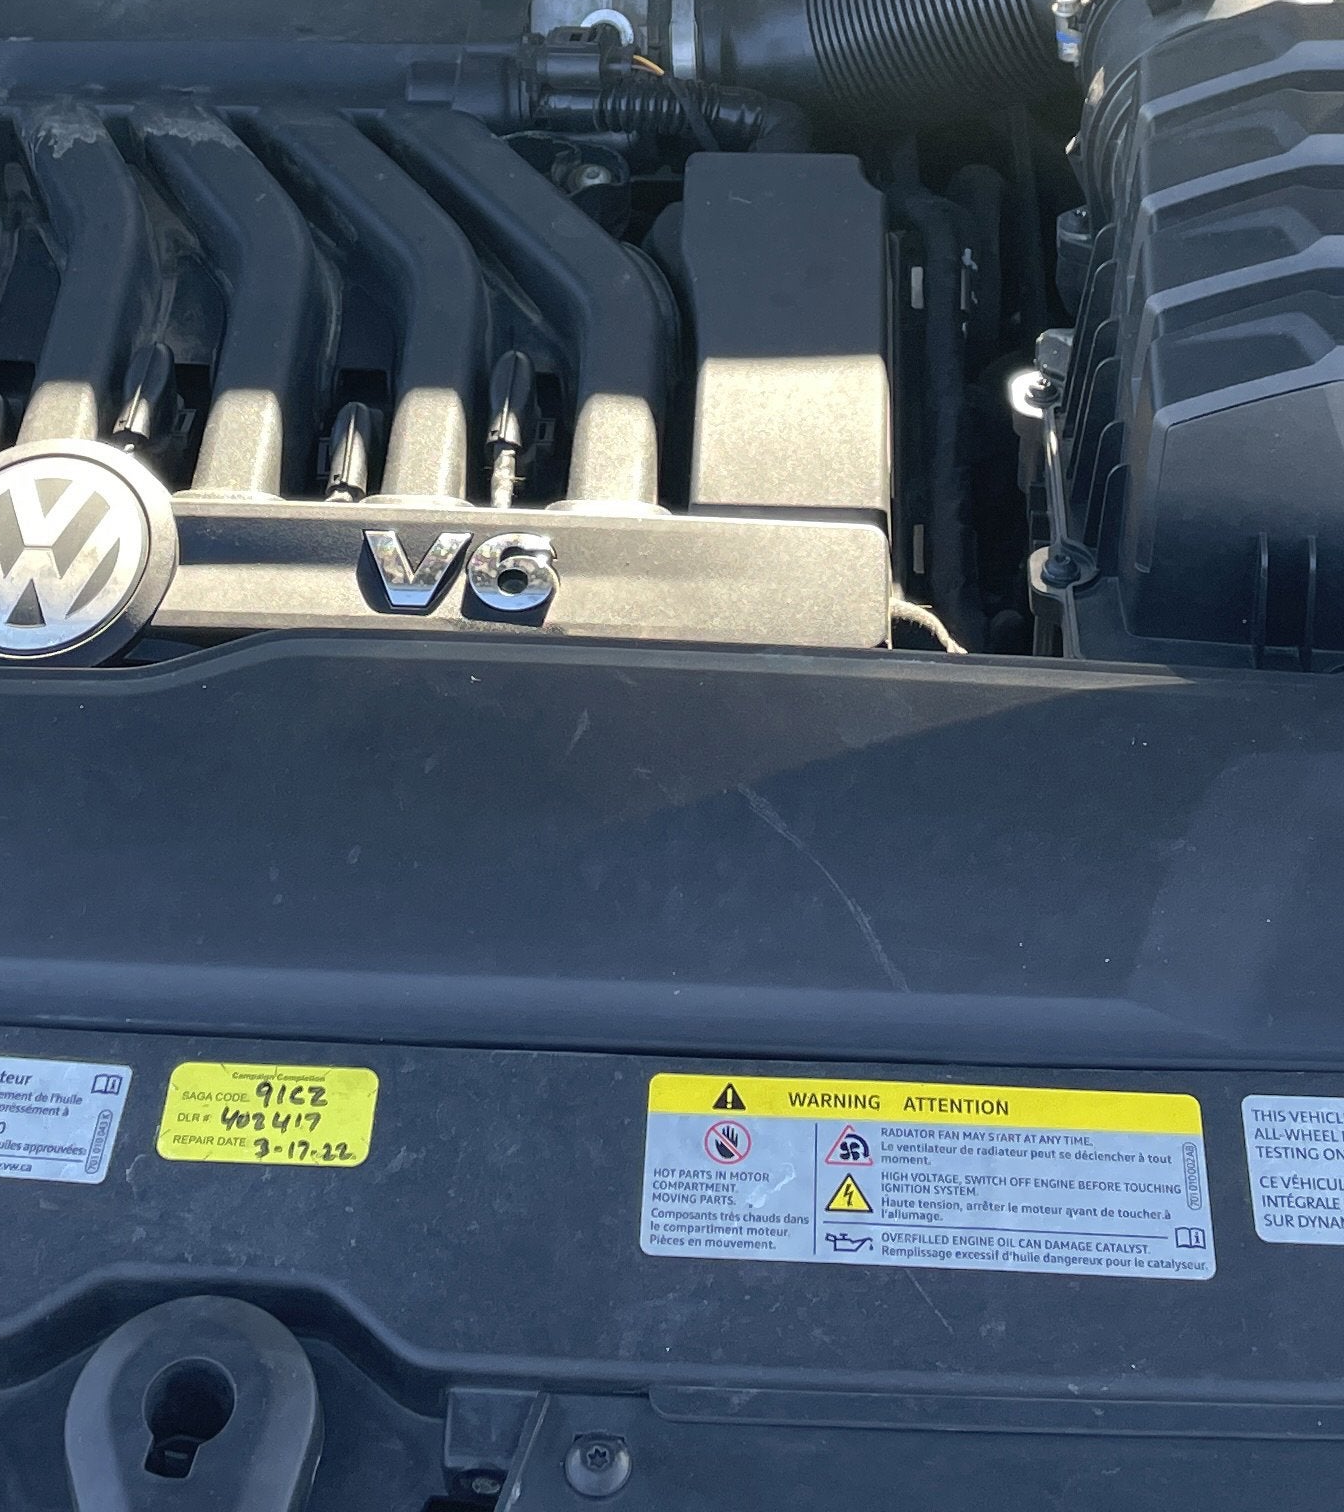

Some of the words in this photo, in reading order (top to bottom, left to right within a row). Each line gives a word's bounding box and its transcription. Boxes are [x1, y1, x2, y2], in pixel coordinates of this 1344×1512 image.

[360, 529, 558, 613] V6
[181, 1090, 212, 1101] SAGA
[214, 1091, 249, 1102] CODE
[788, 1092, 880, 1110] WARNING
[903, 1096, 1008, 1115] ATTENTION
[176, 1112, 200, 1122] DLR
[1250, 1108, 1286, 1122] THIS
[172, 1134, 214, 1145] REPAIR
[216, 1136, 246, 1147] DATE
[880, 1127, 934, 1138] RADIATOR
[938, 1129, 959, 1140] FAN
[962, 1131, 985, 1141] MAY
[987, 1132, 1021, 1142] START
[1023, 1134, 1036, 1143] AT
[1038, 1134, 1061, 1144] ANY
[1062, 1135, 1093, 1146] TIME.
[1254, 1127, 1339, 1142] ALL-WHEEL
[1254, 1145, 1319, 1160] TESTING
[653, 1167, 674, 1178] HOT
[674, 1168, 712, 1179] PARTS
[715, 1170, 726, 1180] IN
[729, 1171, 769, 1182] MOTOR
[1259, 1175, 1278, 1188] CE
[880, 1171, 907, 1184] HIGH
[910, 1172, 962, 1186] VOLTAGE,
[964, 1175, 1004, 1186] SWITCH
[1009, 1176, 1031, 1187] OFF
[1033, 1177, 1075, 1189] ENGINE
[1078, 1180, 1121, 1191] BEFORE
[1123, 1182, 1181, 1194] TOUCHING
[880, 1182, 930, 1194] IGNITION
[934, 1184, 975, 1196] SYSTEM.
[651, 1192, 696, 1203] MOVING
[699, 1194, 736, 1205] PARTS.
[1261, 1193, 1340, 1210] INTÉGRALE
[1263, 1213, 1295, 1227] SUR
[881, 1232, 948, 1244] OVERFILLED
[952, 1235, 994, 1249] ENGINE
[996, 1237, 1016, 1247] OIL
[1018, 1238, 1041, 1249] CAN
[1044, 1239, 1092, 1251] DAMAGE
[1095, 1241, 1147, 1254] CATALYST.
